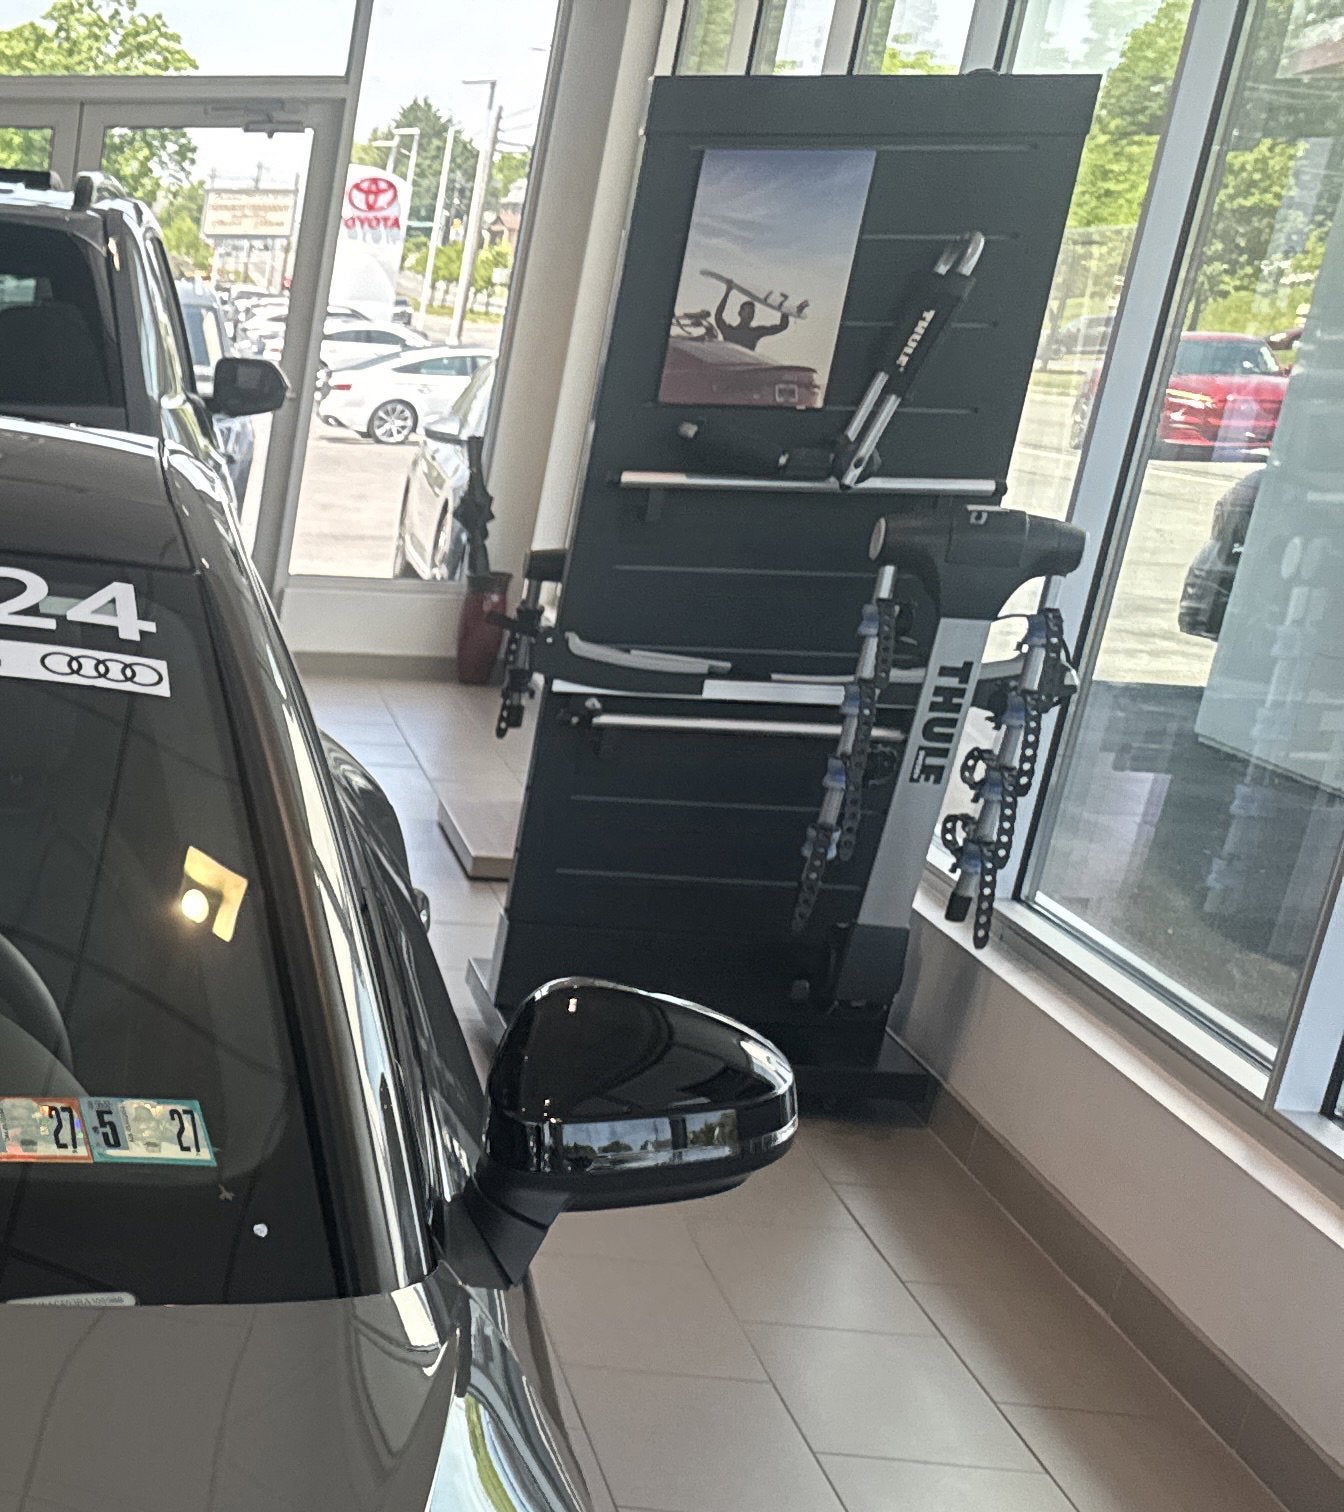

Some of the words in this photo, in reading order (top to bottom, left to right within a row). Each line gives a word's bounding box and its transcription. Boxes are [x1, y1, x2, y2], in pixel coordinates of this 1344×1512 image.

[344, 216, 401, 231] OYOTA
[895, 309, 936, 368] THULE
[909, 660, 974, 784] THULE
[48, 1105, 78, 1149] 27
[96, 1110, 122, 1148] 5
[169, 1108, 201, 1152] 27
